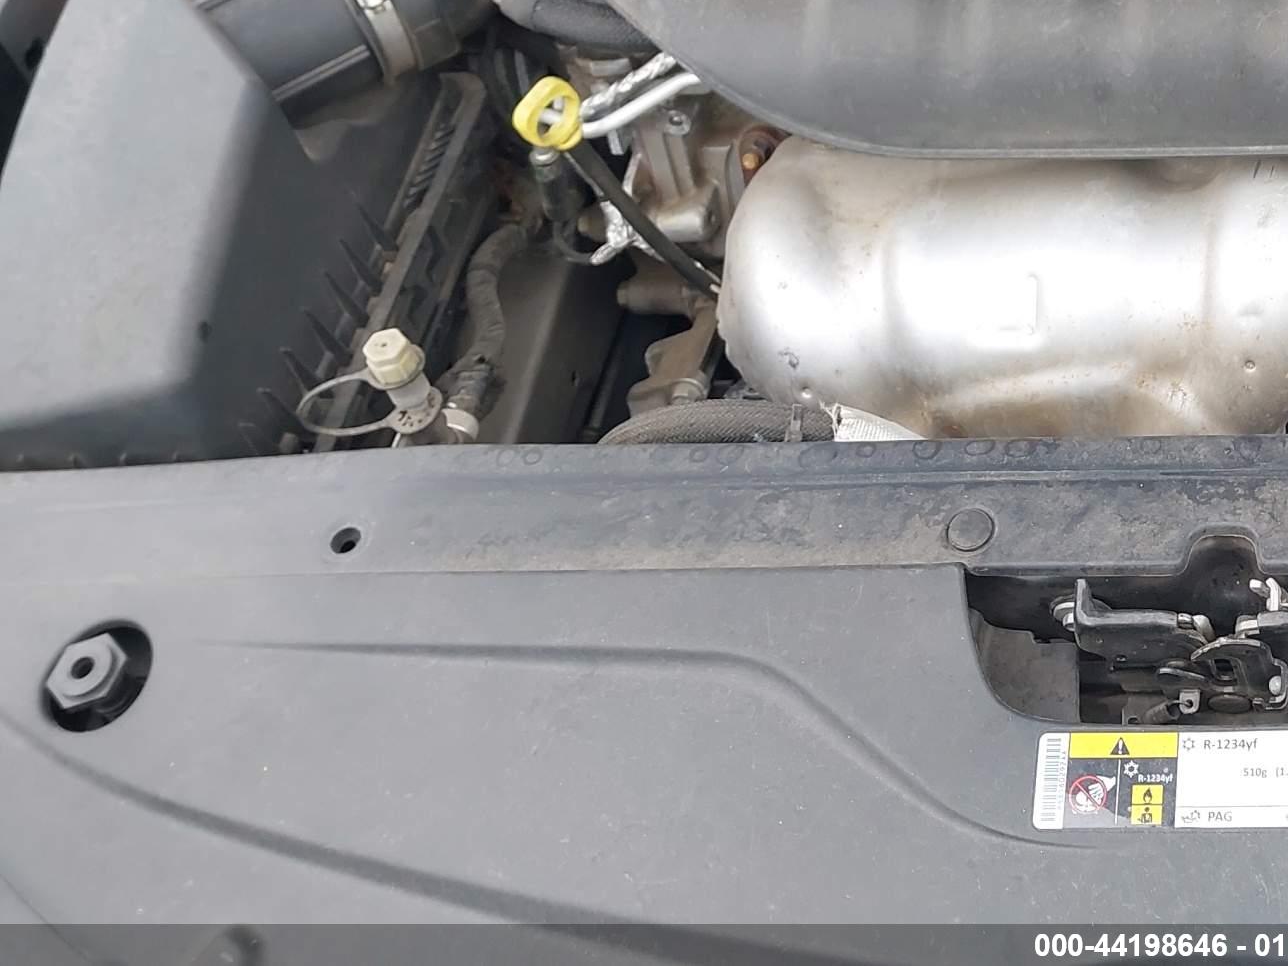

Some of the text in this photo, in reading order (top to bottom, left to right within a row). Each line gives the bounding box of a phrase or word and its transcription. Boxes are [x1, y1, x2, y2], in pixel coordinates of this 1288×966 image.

[1203, 737, 1259, 752] R-1234yf
[1242, 767, 1268, 778] 510g
[1137, 773, 1174, 784] R-1234yf
[1207, 810, 1234, 822] PAG
